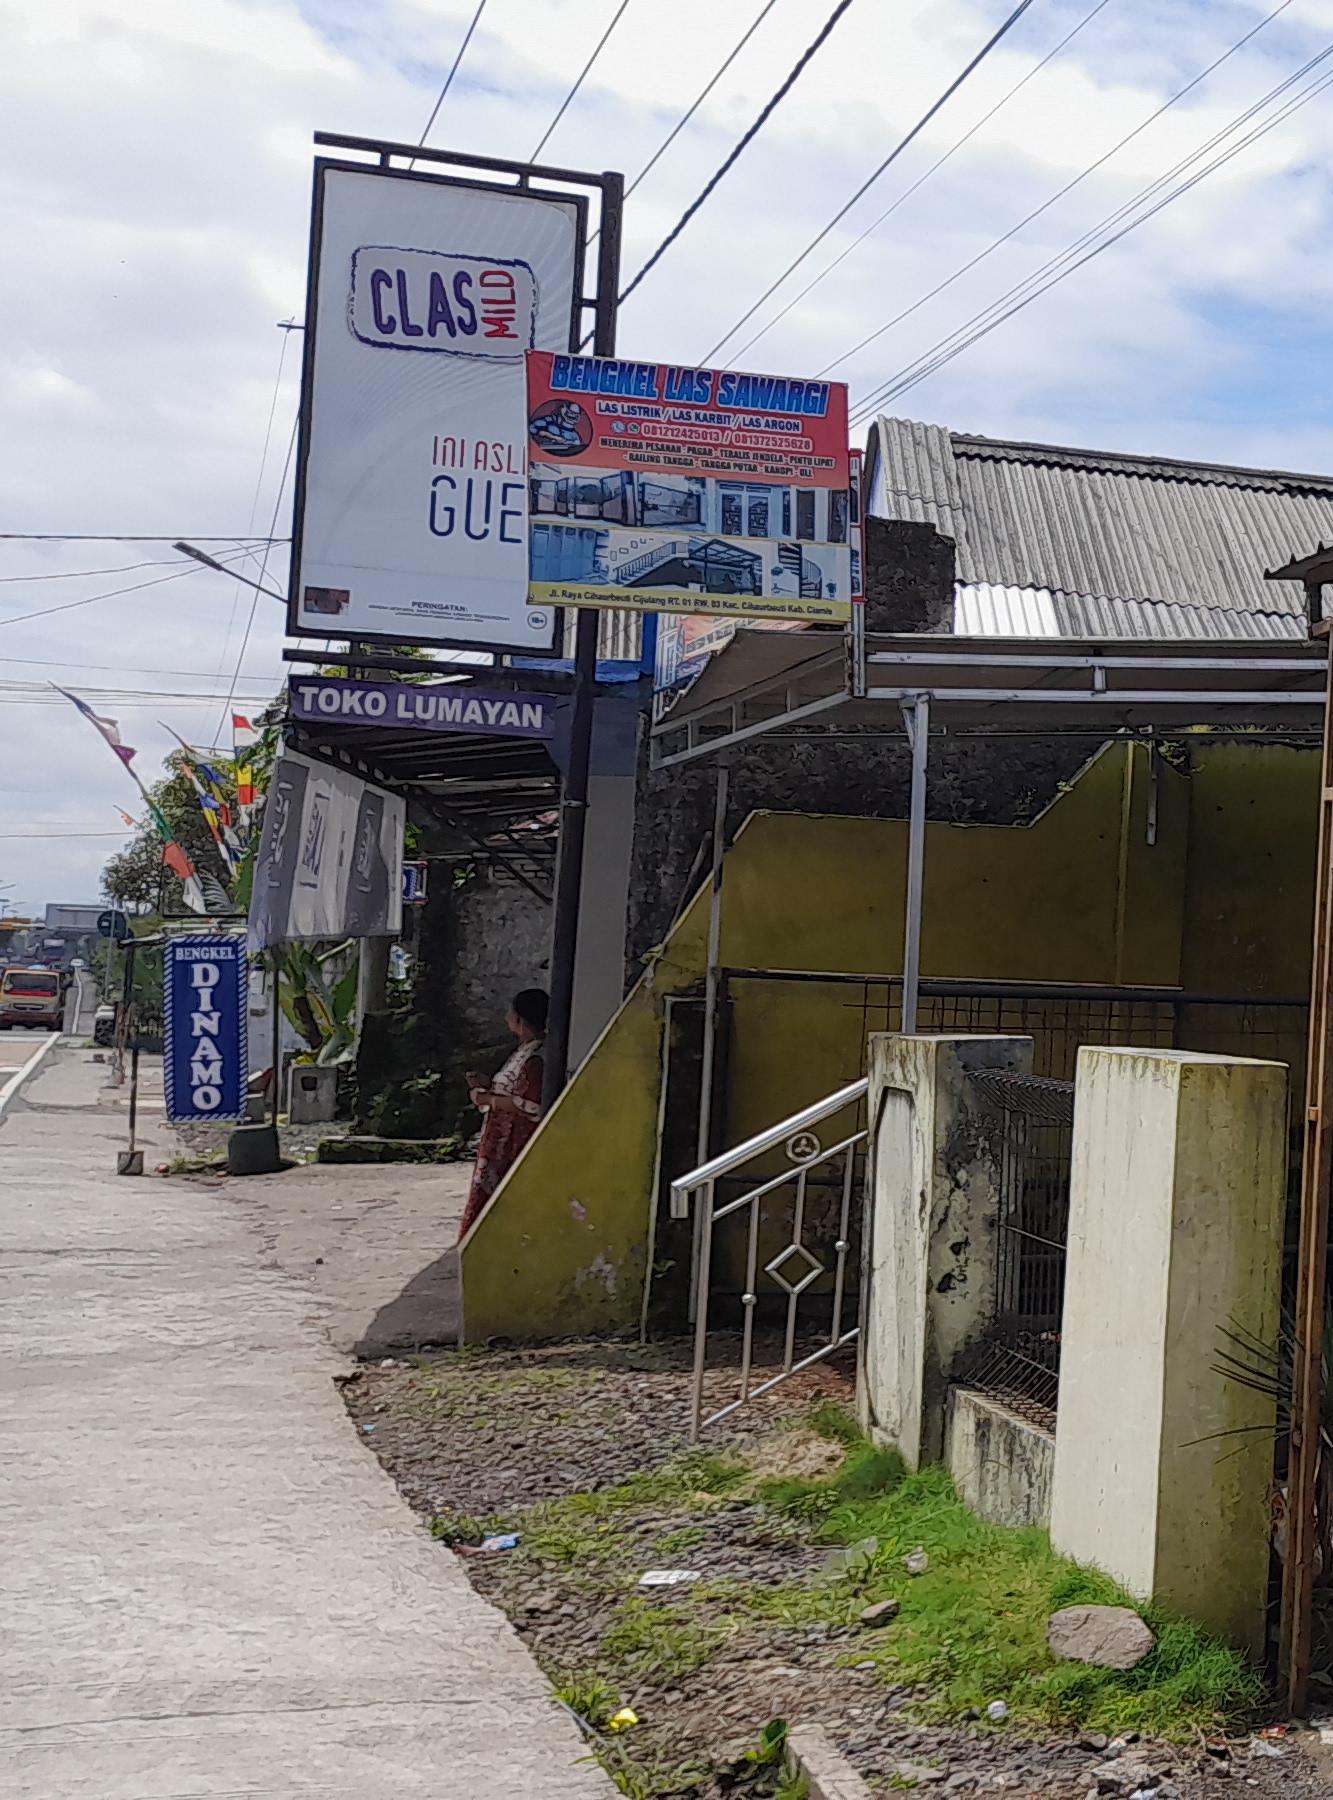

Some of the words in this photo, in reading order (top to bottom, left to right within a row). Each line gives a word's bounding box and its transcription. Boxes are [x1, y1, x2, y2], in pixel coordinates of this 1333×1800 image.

[370, 268, 478, 338] CLAS
[479, 270, 519, 338] MILD
[551, 354, 658, 398] BENGKEL
[664, 366, 712, 404] LAS
[718, 373, 829, 415] SAWARGI
[598, 401, 618, 413] LAS
[621, 403, 661, 418] LISTRIK
[672, 410, 692, 421] LAS
[695, 411, 731, 425] KARBIT
[742, 418, 761, 428] LAS
[765, 420, 800, 432] ARGON
[432, 436, 465, 468] INI
[474, 441, 526, 475] ASLI
[429, 474, 526, 544] GUE
[298, 686, 387, 716] TOKO
[396, 693, 543, 728] LUMAYAN
[175, 947, 236, 961] BENGKEL
[190, 963, 224, 1111] DINAMO
